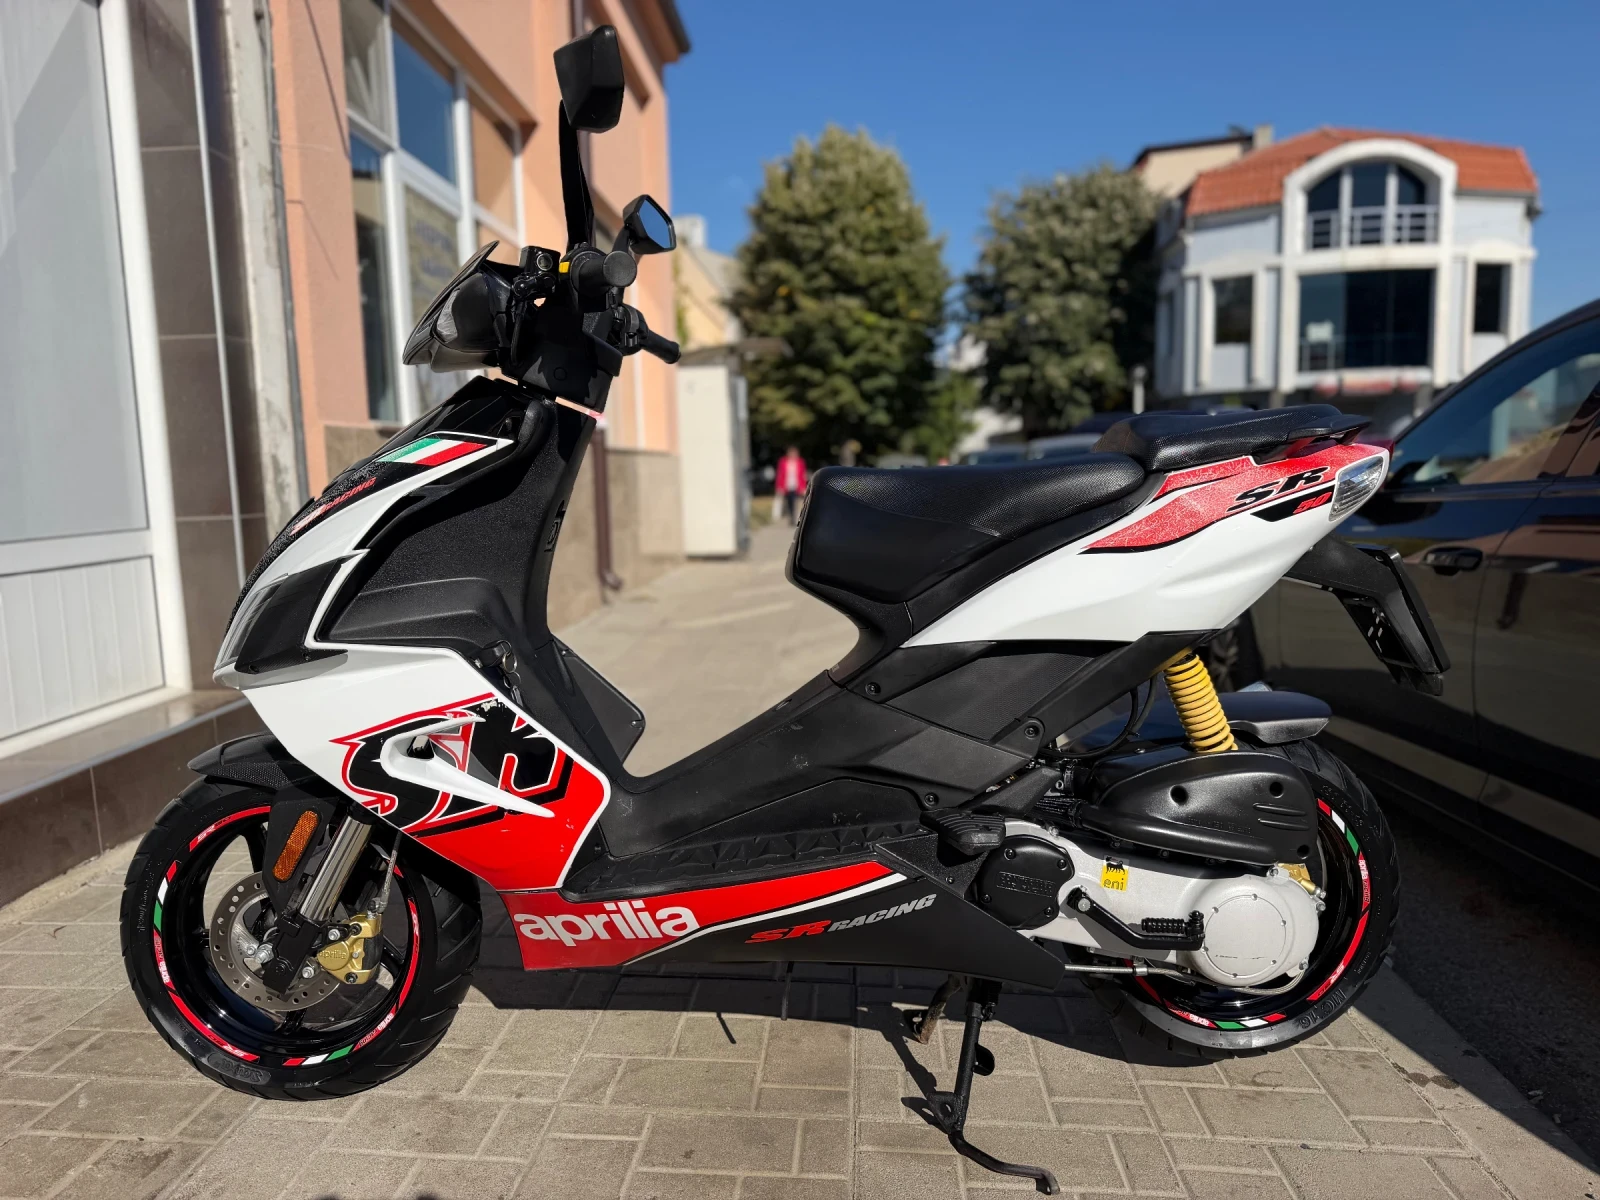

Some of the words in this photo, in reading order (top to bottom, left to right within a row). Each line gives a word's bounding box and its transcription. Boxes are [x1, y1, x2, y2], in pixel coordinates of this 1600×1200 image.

[1225, 466, 1331, 513] SR
[1293, 492, 1332, 514] 50
[1103, 877, 1125, 891] eni
[513, 901, 700, 947] aprilia
[745, 919, 832, 944] SR
[827, 893, 937, 932] RACING
